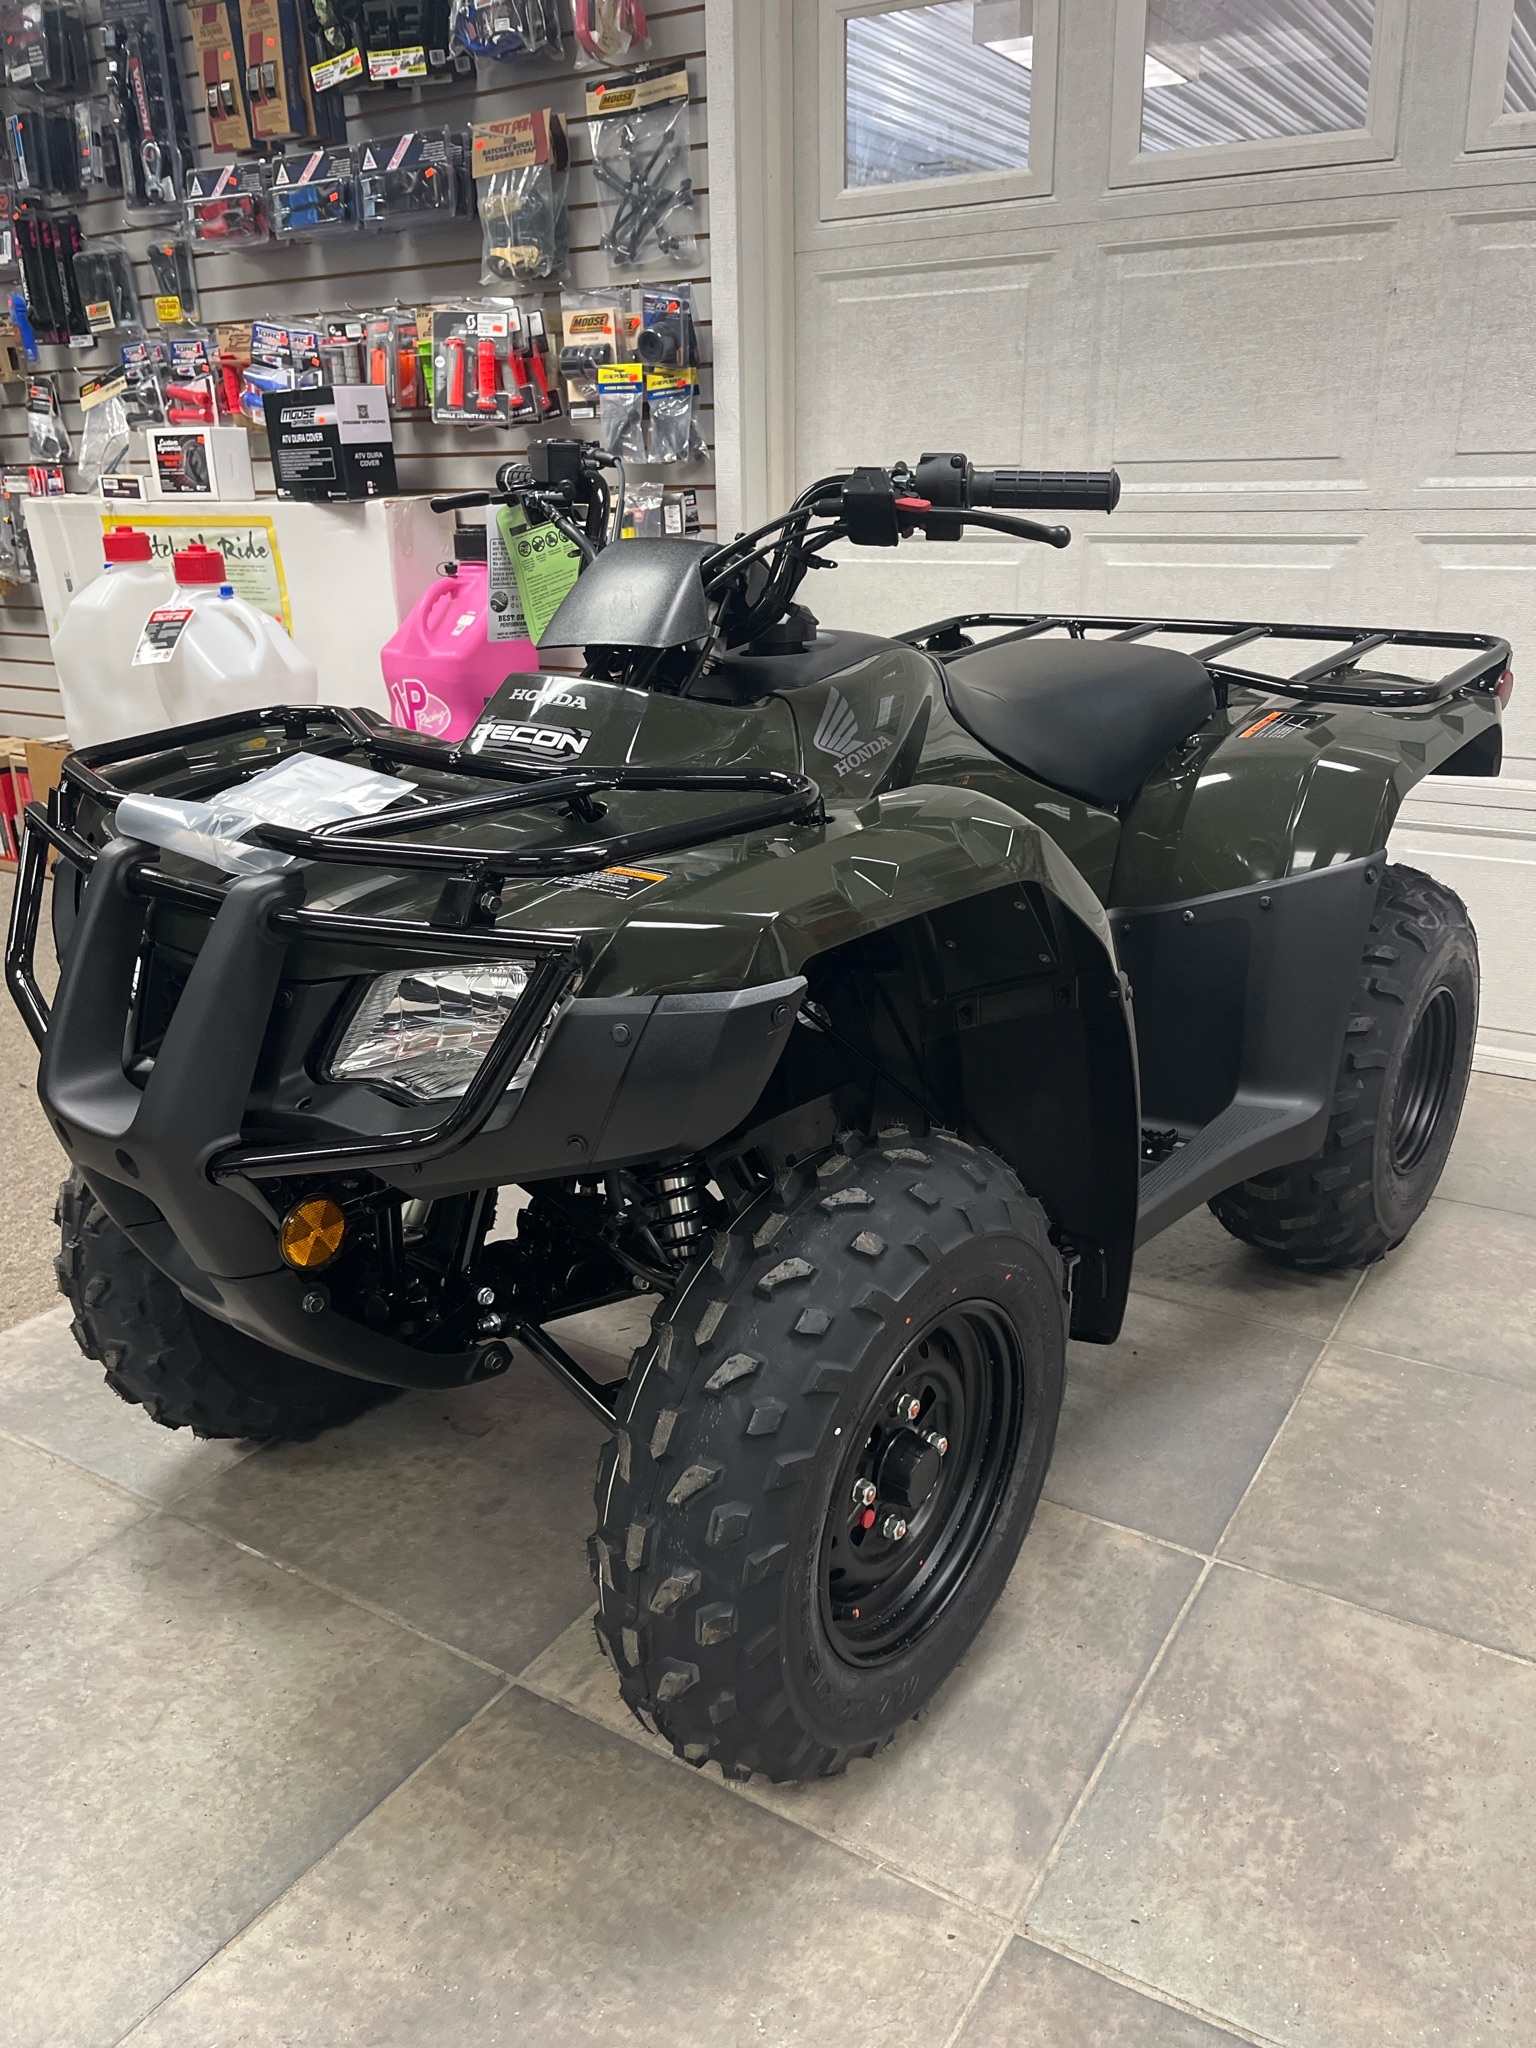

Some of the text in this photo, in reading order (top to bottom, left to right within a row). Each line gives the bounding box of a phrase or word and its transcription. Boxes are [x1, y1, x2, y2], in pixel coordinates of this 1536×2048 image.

[603, 92, 633, 104] MOOSE
[573, 315, 605, 327] MOOSE
[282, 408, 316, 420] MOOSE
[160, 438, 179, 446] Custom
[281, 432, 324, 444] ATV DURA COVER
[354, 452, 366, 460] ATV
[498, 613, 525, 622] BEST ON
[391, 679, 428, 731] VP
[508, 688, 587, 710] HONDA
[418, 710, 449, 731] Racing
[470, 723, 589, 754] RECON
[833, 735, 893, 778] HONDA
